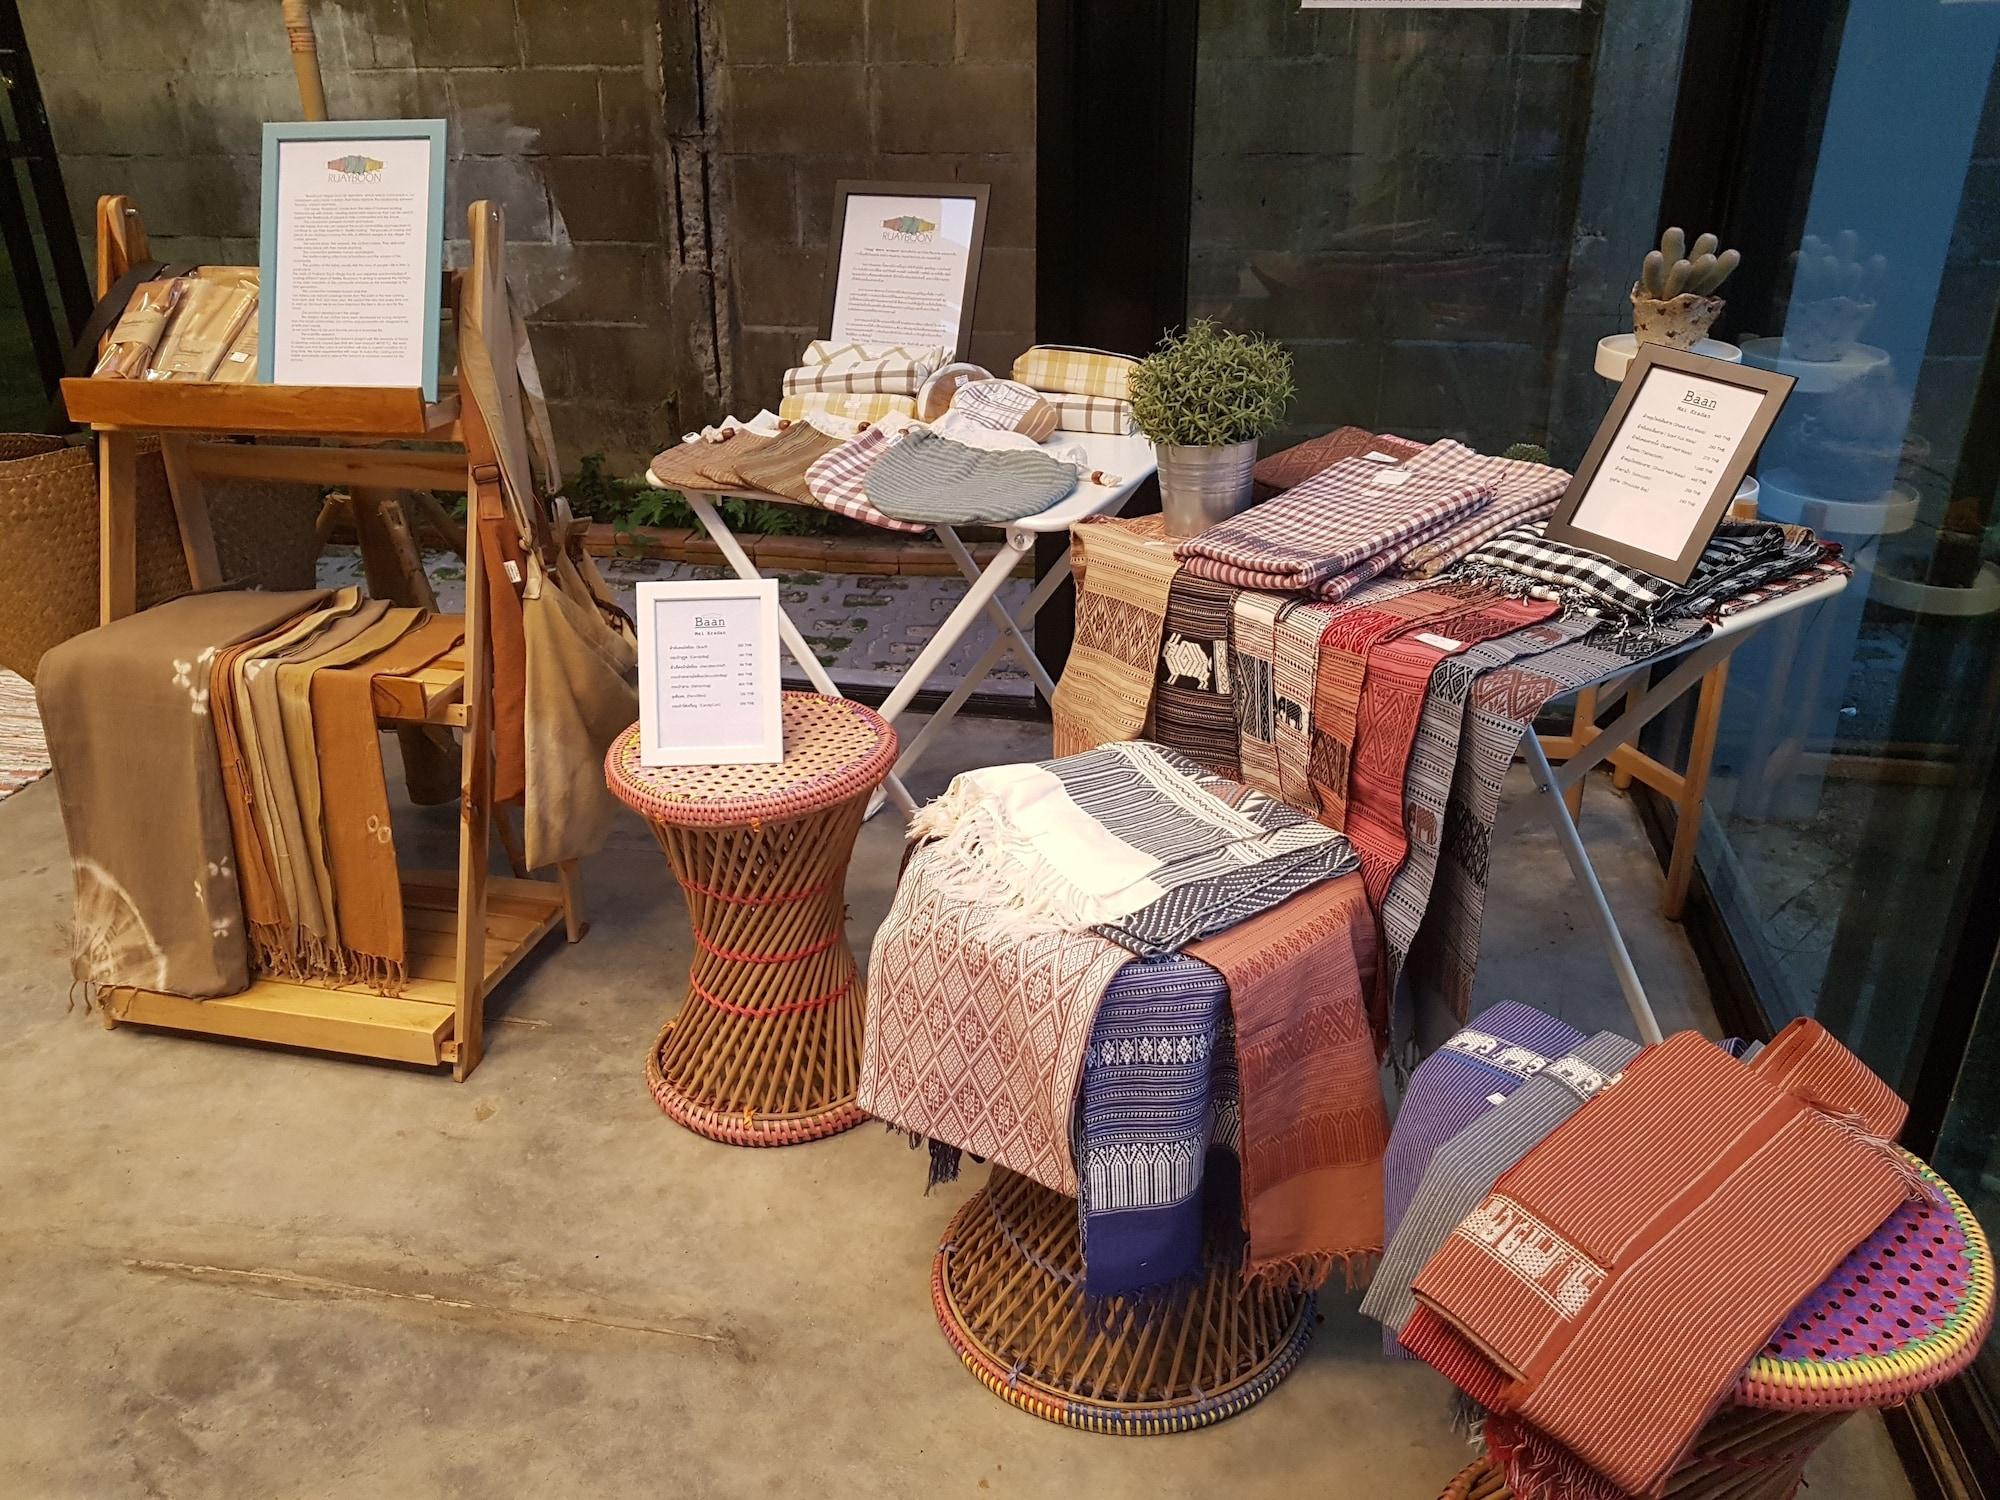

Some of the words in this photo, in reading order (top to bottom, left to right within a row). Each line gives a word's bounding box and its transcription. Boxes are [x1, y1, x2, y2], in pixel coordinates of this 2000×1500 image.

[328, 173, 382, 183] RUAYBOON
[882, 231, 932, 242] RUAYBOON
[1683, 390, 1717, 409] Baan
[695, 616, 726, 627] Baan
